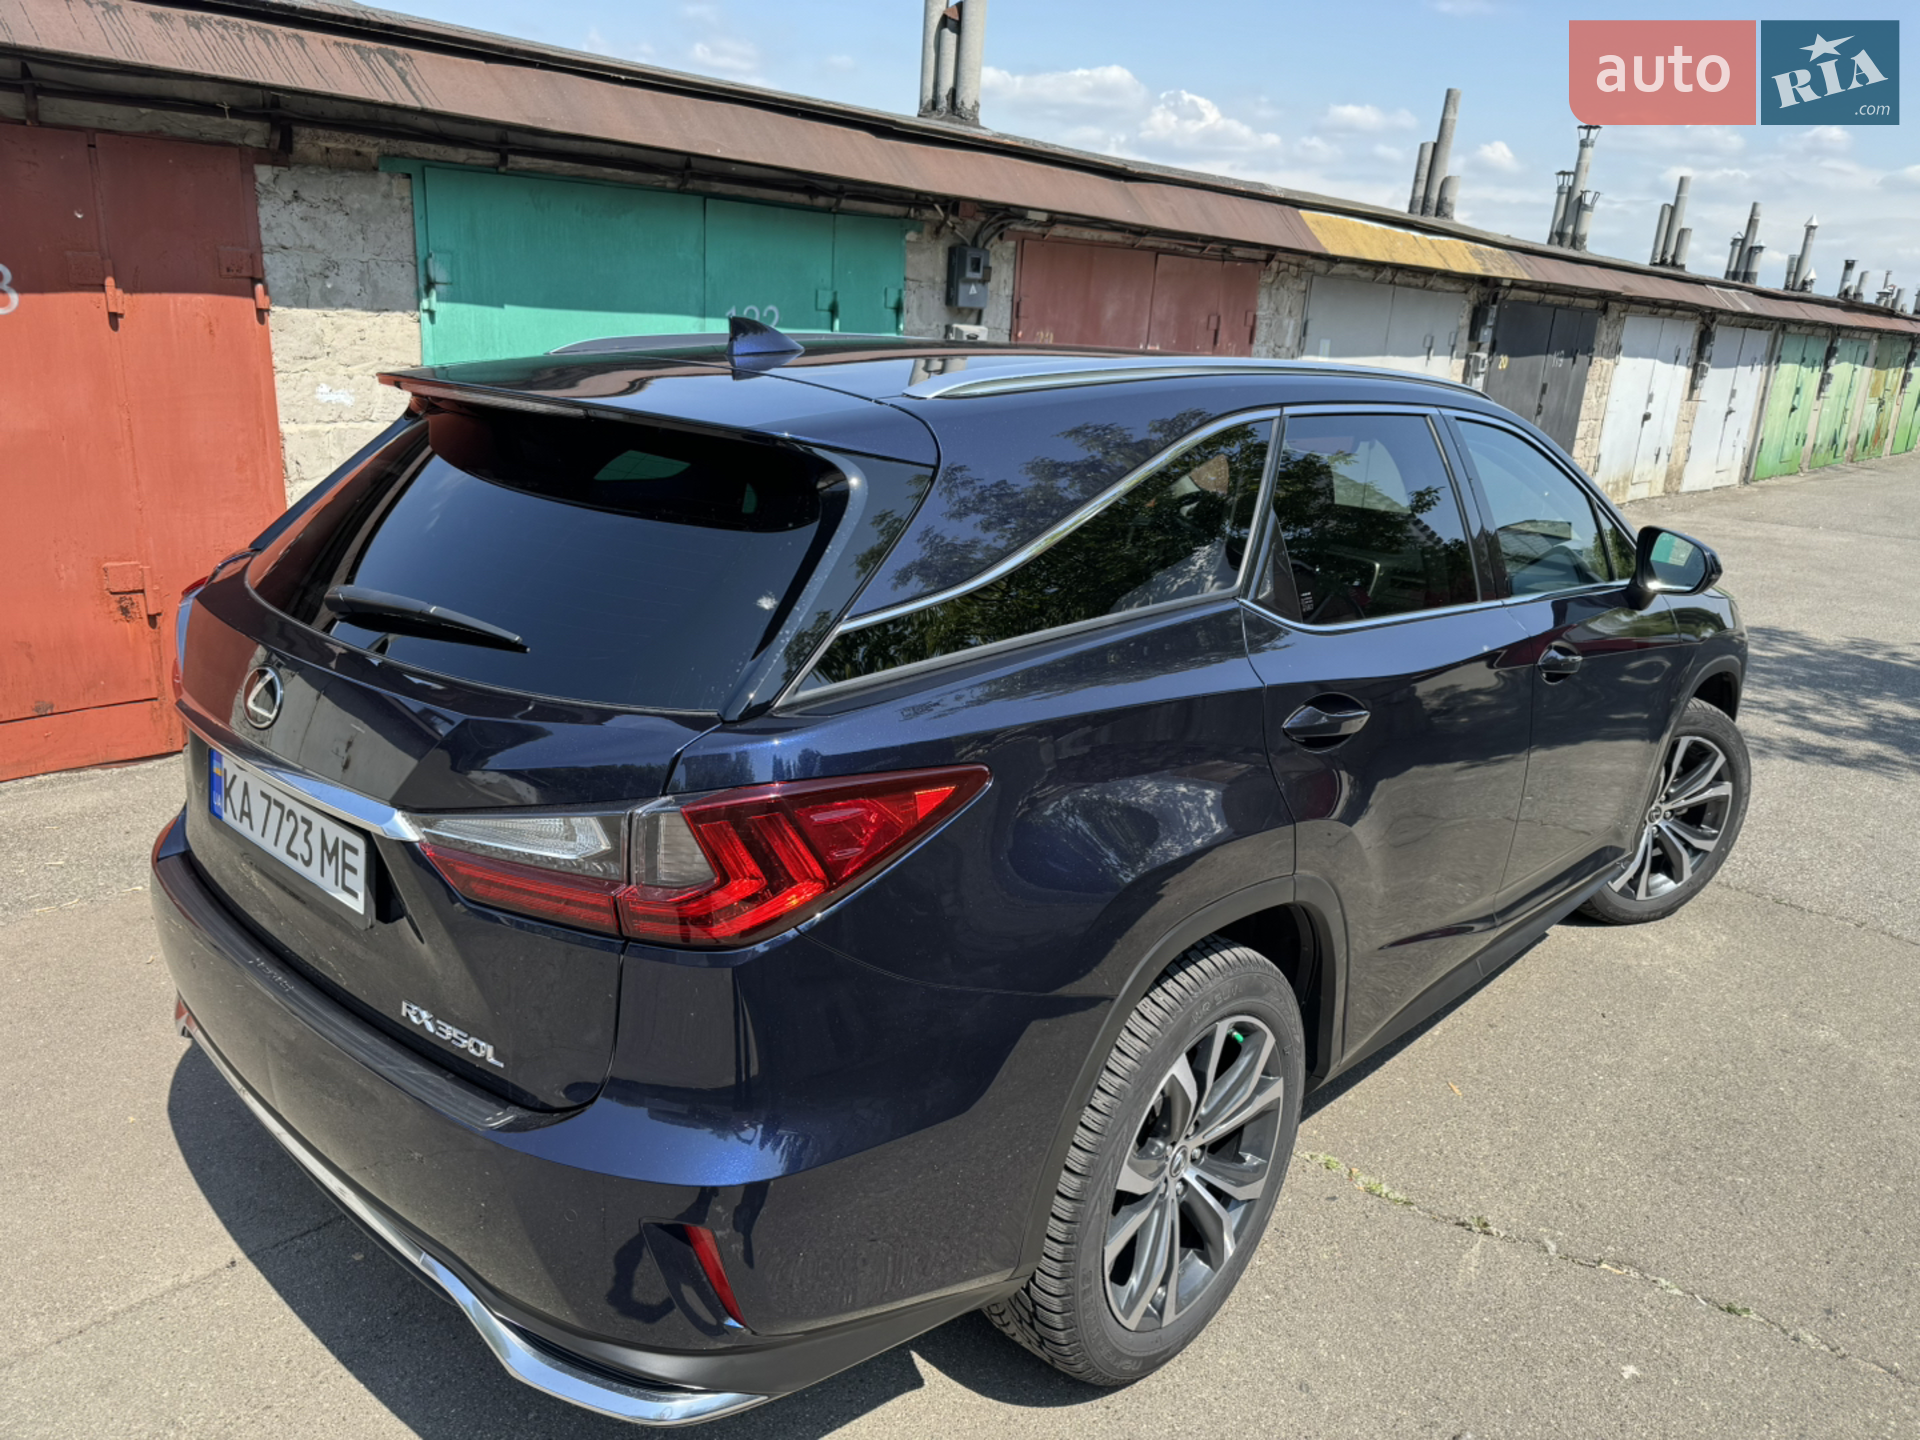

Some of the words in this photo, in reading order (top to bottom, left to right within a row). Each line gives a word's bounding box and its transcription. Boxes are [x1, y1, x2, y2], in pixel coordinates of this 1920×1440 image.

[223, 767, 255, 832] KA
[259, 788, 314, 868] 7723
[319, 826, 360, 901] ME
